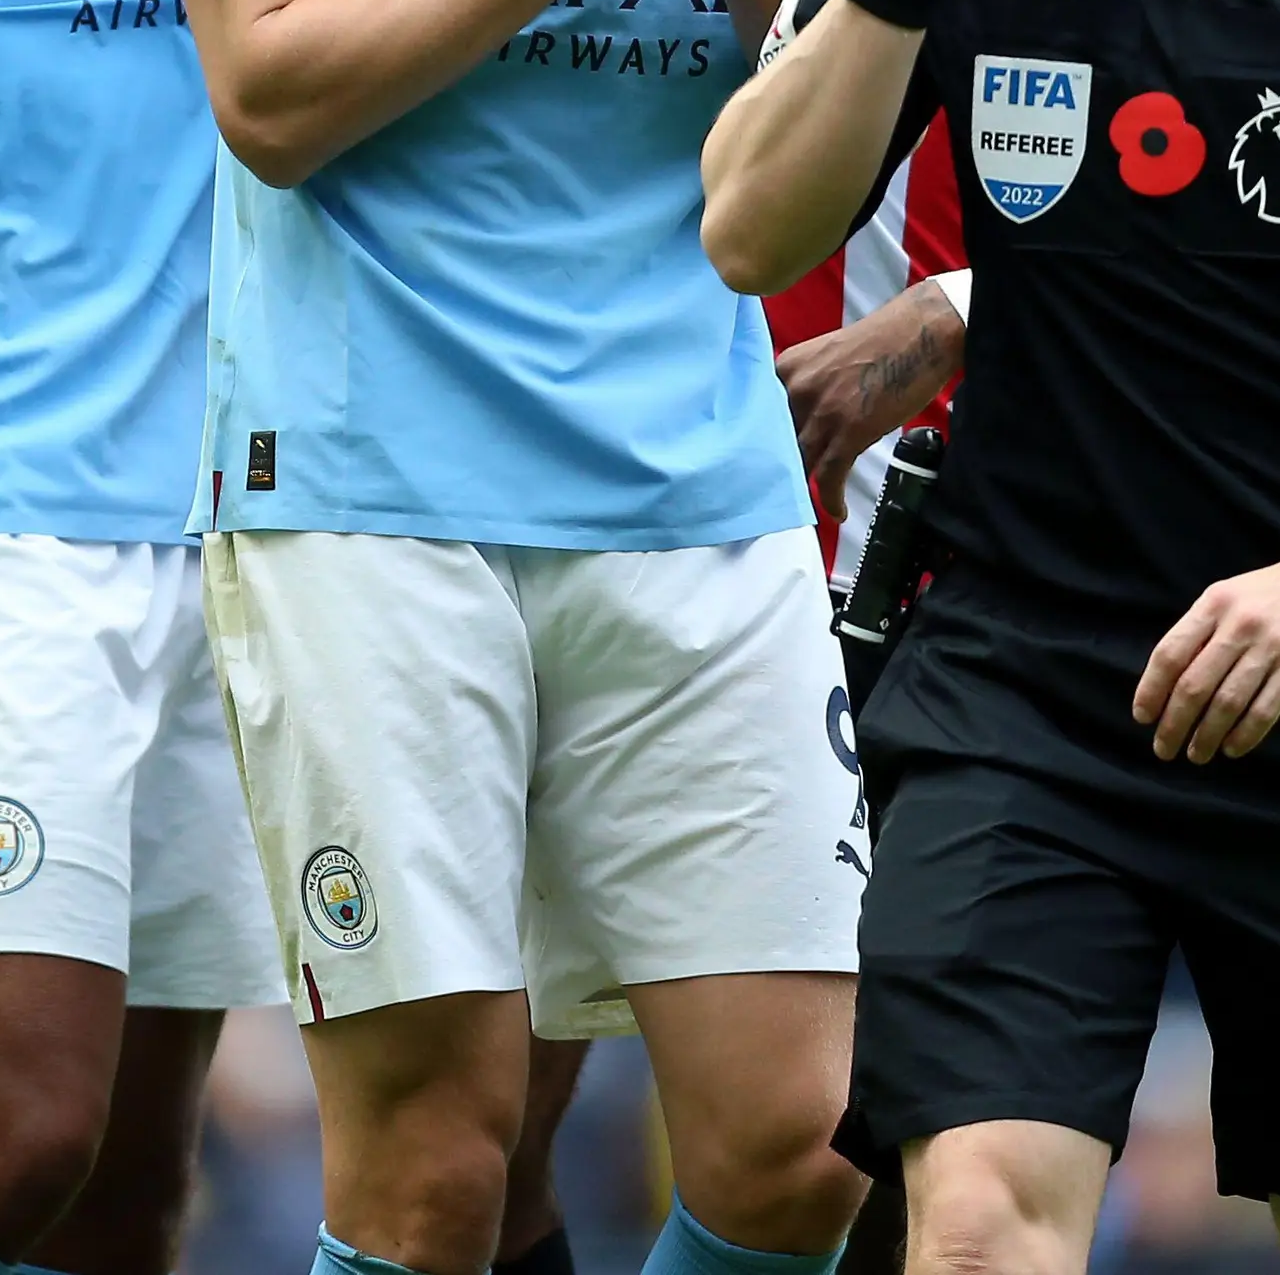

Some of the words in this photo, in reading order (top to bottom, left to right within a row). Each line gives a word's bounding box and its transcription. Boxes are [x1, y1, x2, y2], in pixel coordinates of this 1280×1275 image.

[983, 67, 1076, 110] FIFA
[980, 131, 1074, 156] REFEREE
[1001, 186, 1043, 206] 2022
[309, 854, 363, 891] MANCHESTER
[343, 929, 364, 942] CITY
